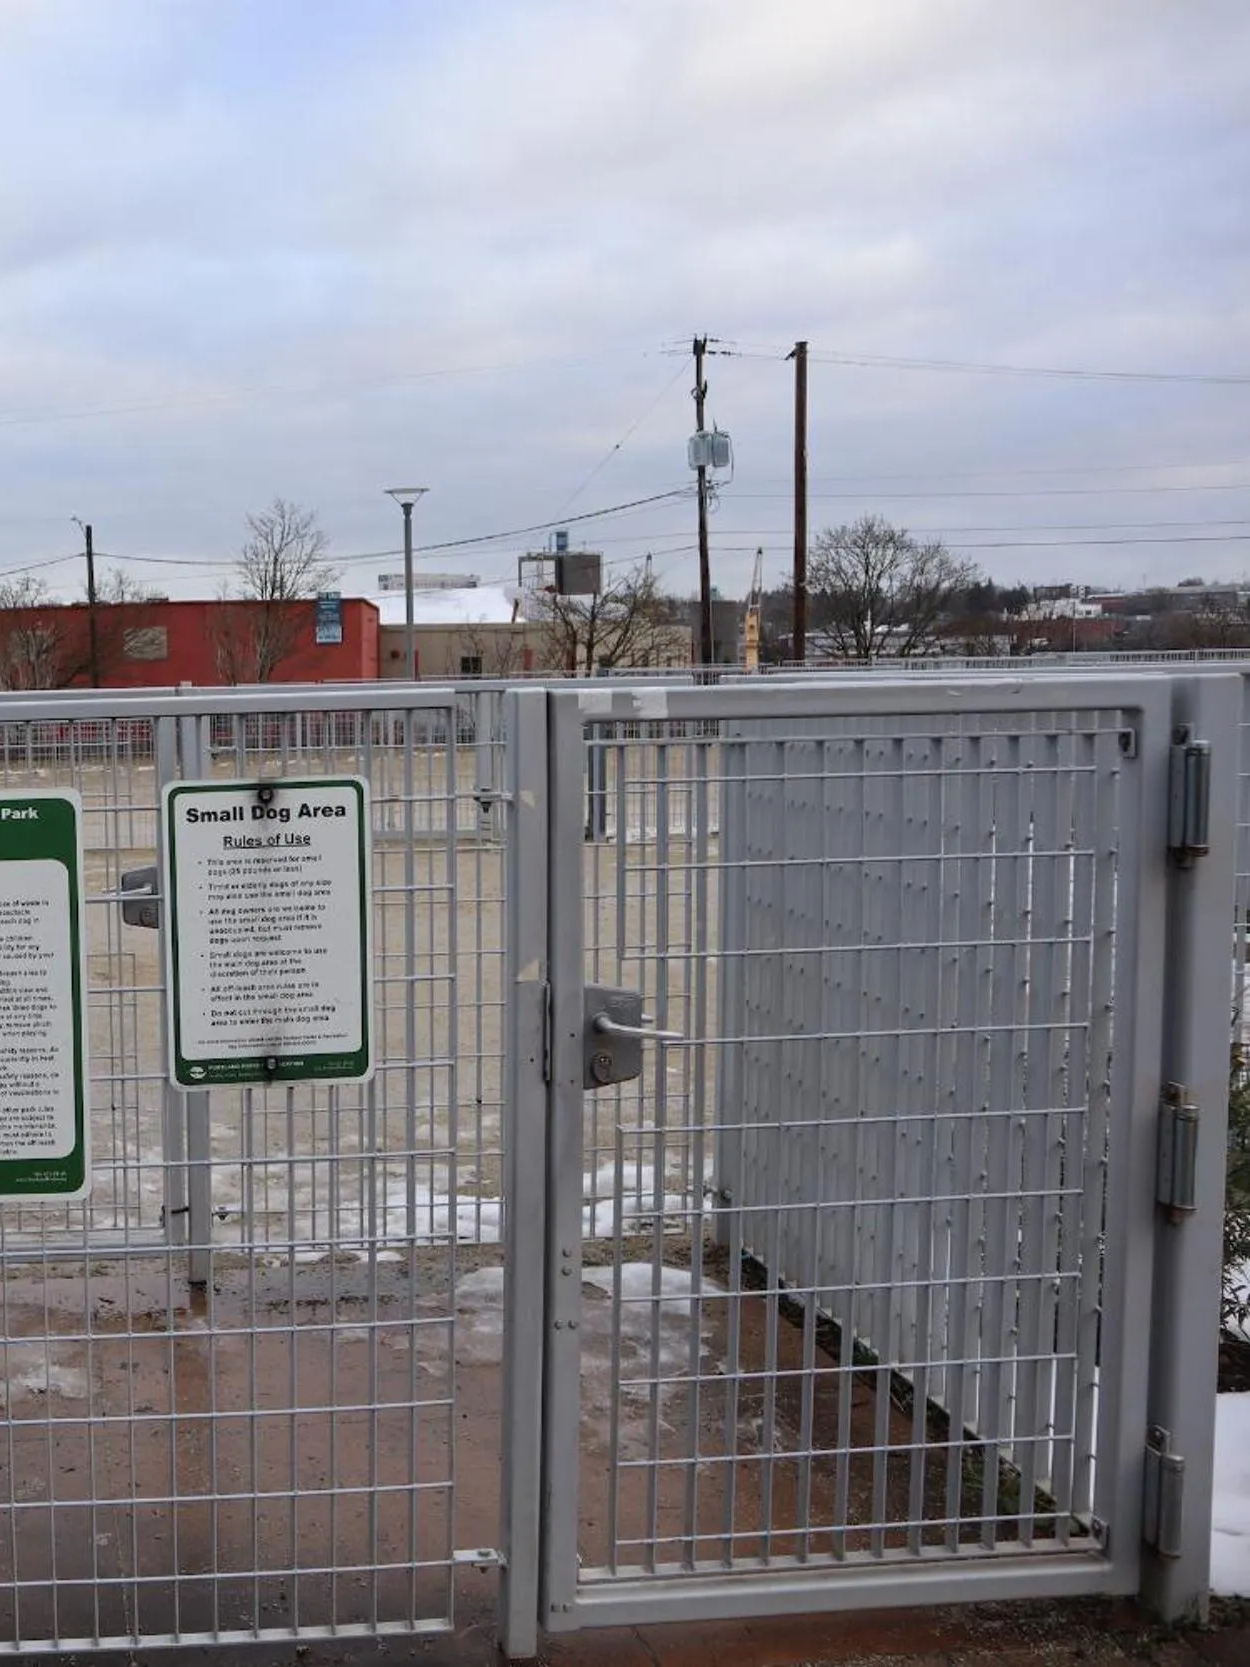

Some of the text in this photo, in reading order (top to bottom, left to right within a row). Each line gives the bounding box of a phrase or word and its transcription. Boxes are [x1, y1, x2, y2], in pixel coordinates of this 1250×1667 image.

[1, 808, 39, 820] Park
[186, 803, 346, 823] Small Dog Area
[223, 833, 311, 849] Rules of Use
